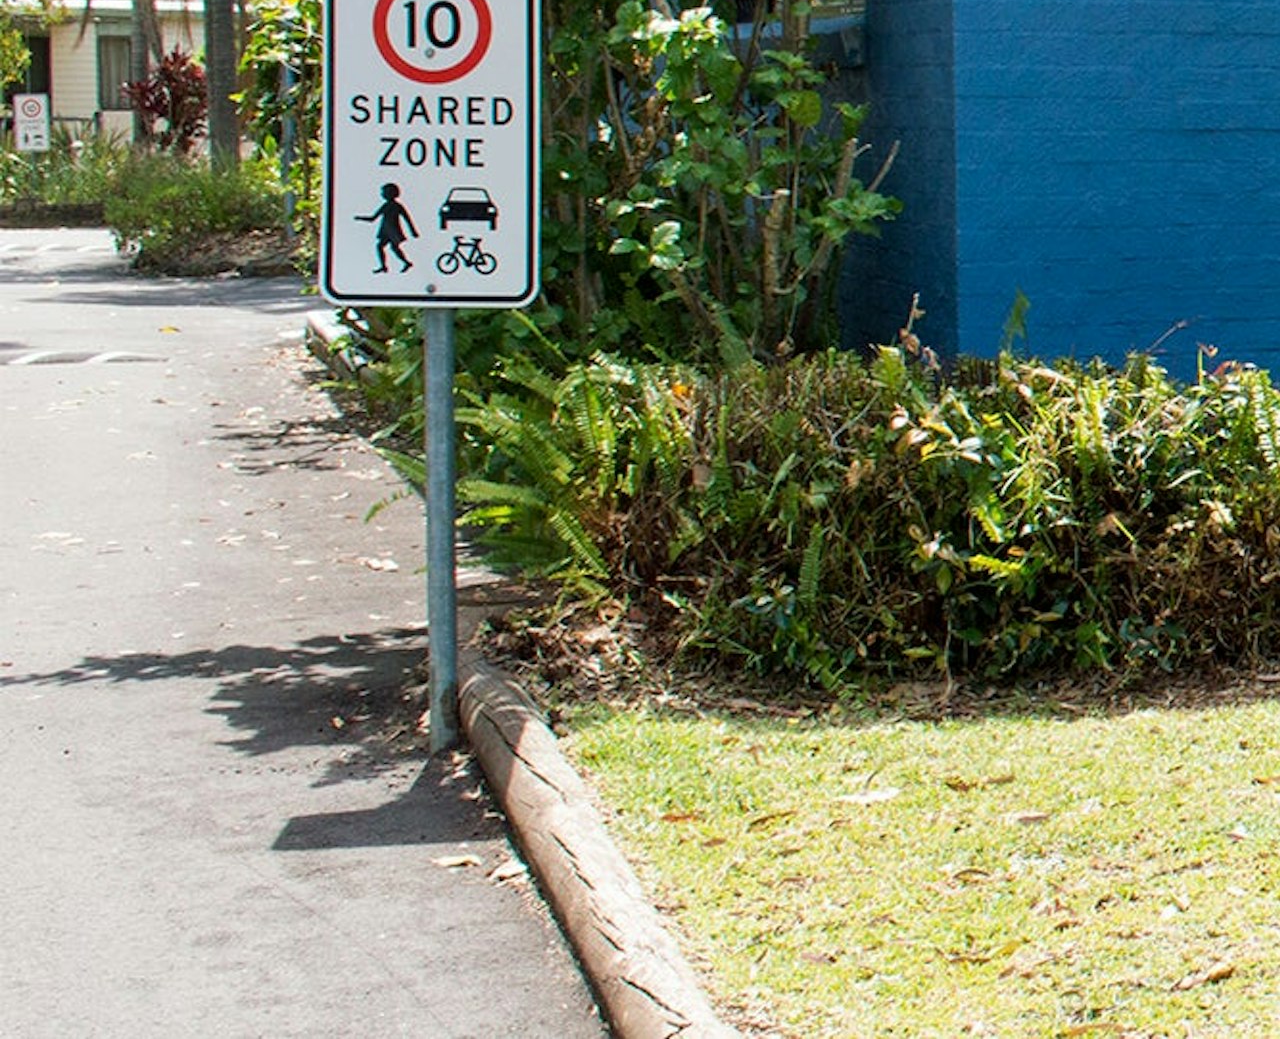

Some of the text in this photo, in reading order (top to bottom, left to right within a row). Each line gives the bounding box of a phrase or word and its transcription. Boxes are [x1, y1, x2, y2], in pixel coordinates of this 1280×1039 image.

[402, 0, 461, 50] 10
[350, 94, 514, 126] SHARED
[379, 137, 485, 168] ZONE
